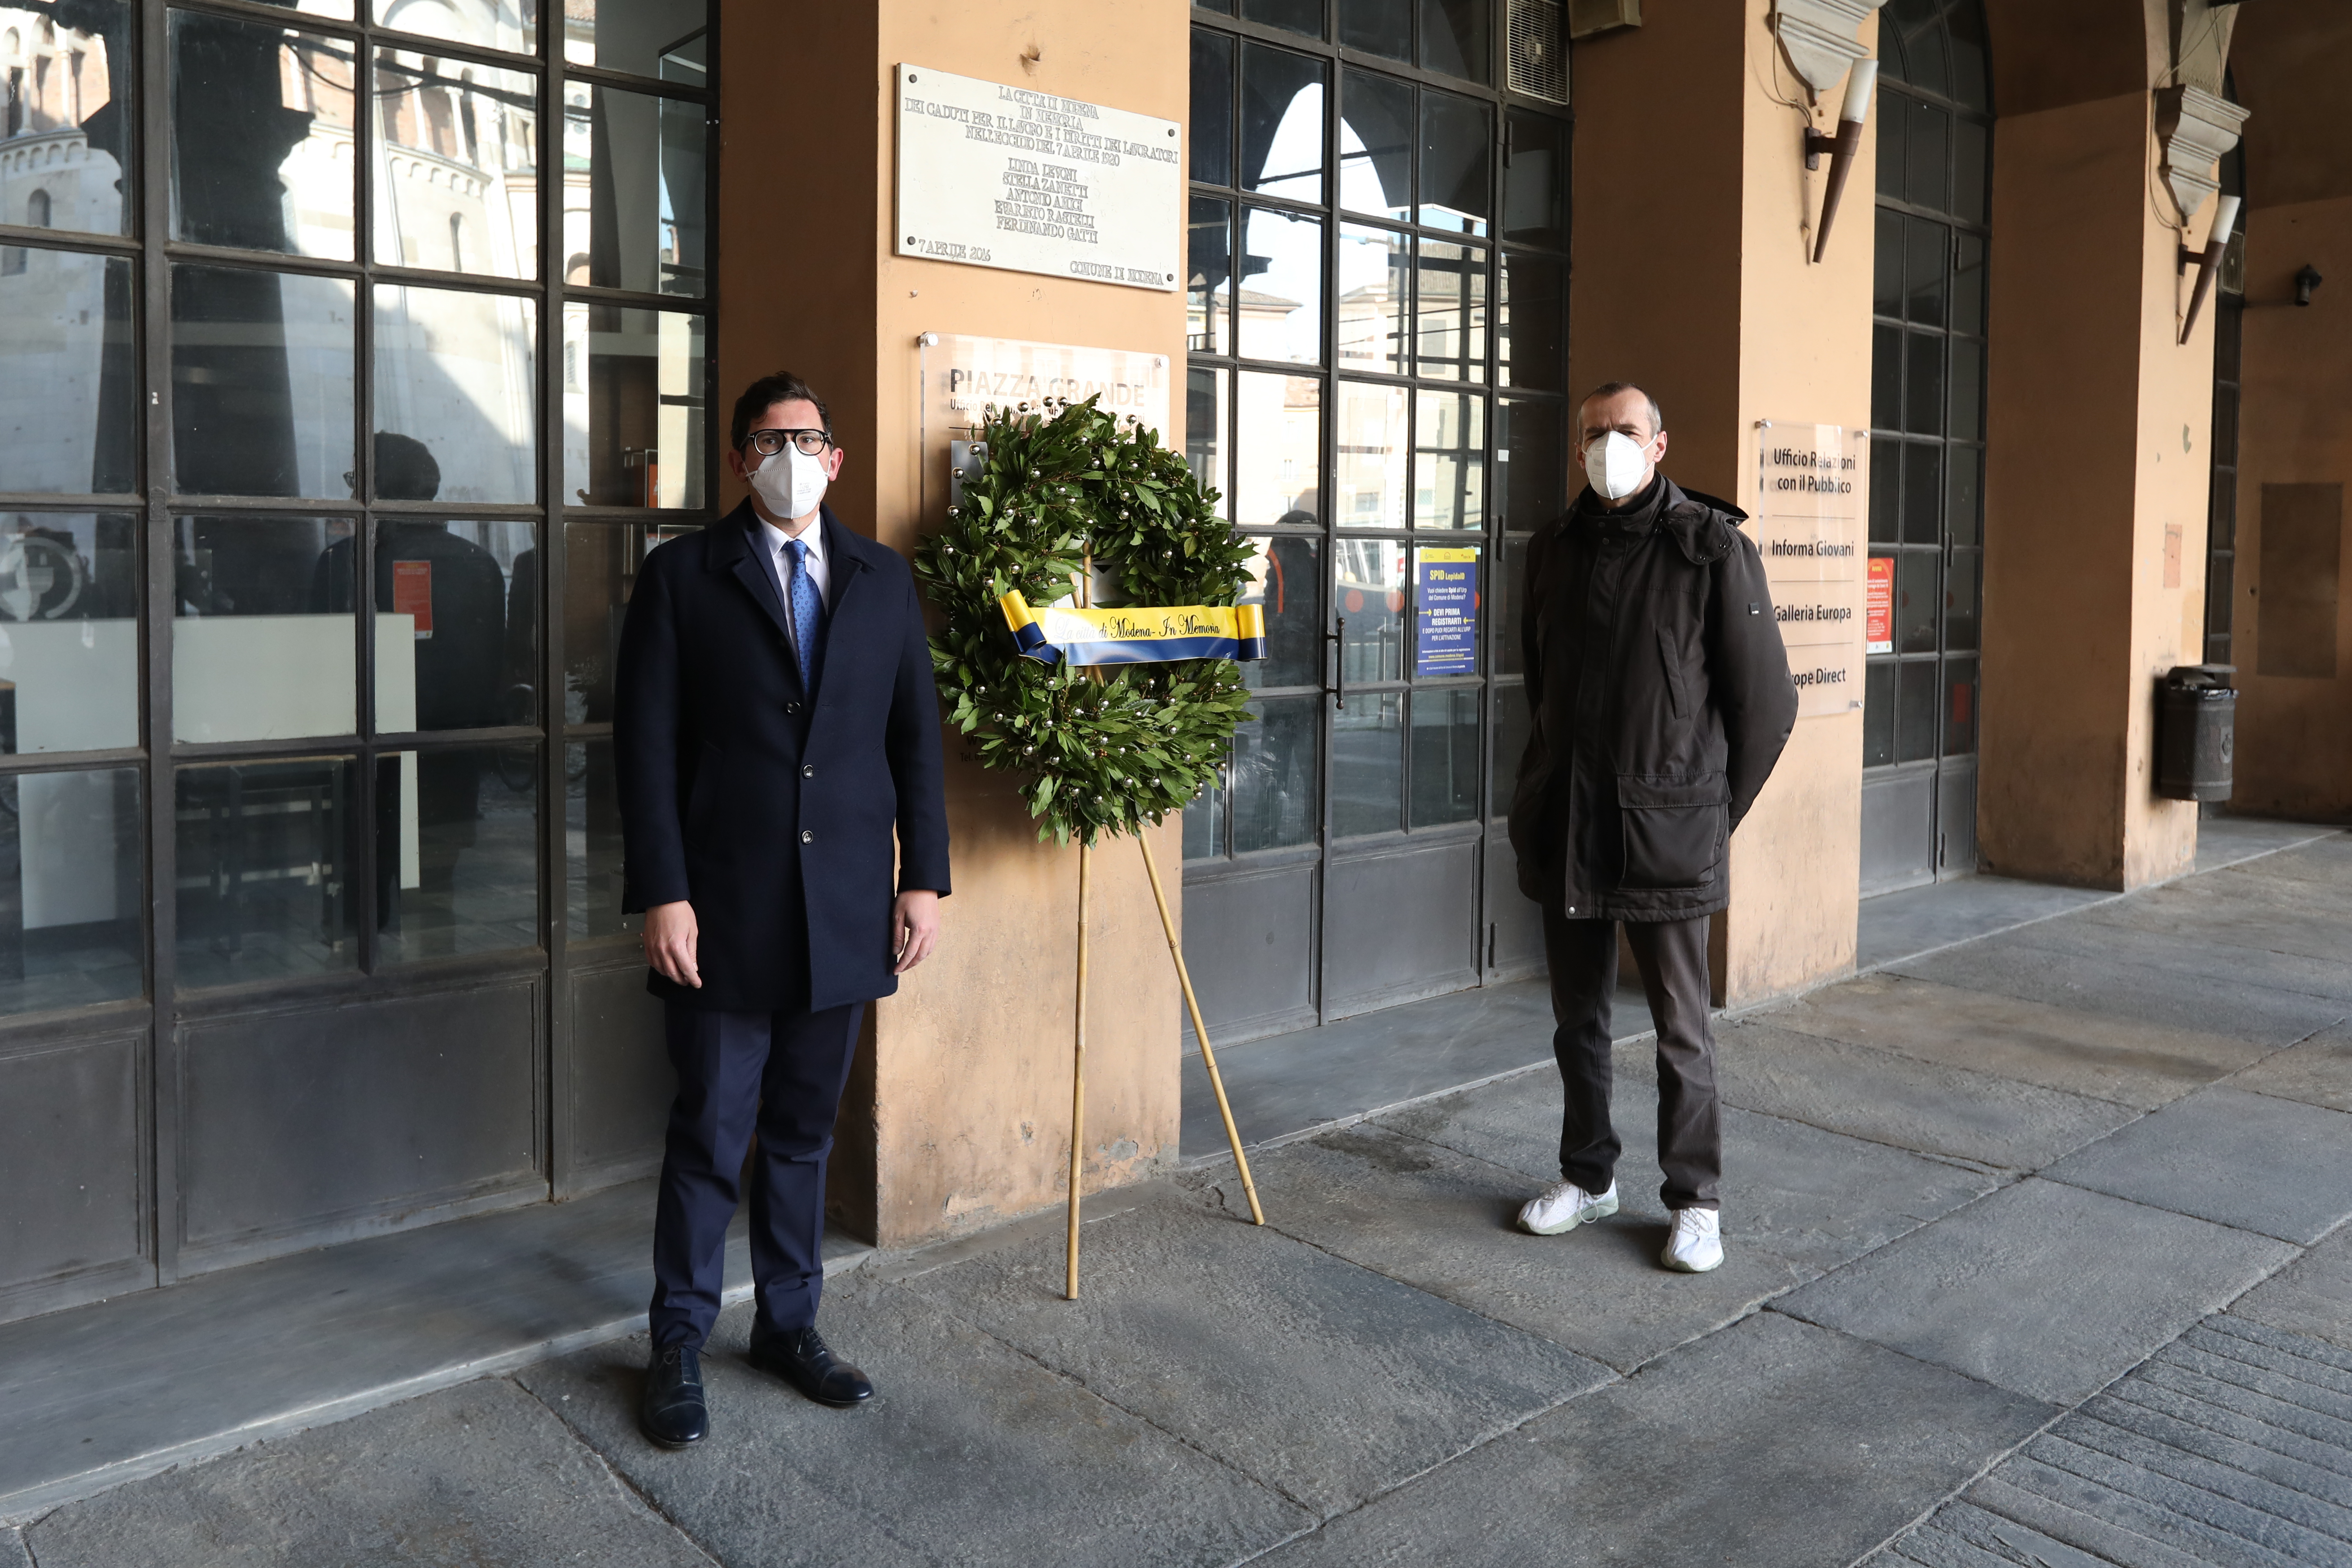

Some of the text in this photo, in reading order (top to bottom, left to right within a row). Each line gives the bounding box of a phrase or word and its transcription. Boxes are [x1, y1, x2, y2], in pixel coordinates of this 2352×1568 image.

[999, 86, 1012, 101] LA
[1047, 96, 1057, 110] DI
[1061, 100, 1099, 119] MODENA
[1020, 105, 1083, 131] IN MEMORIA
[905, 98, 1178, 164] DEI CADUTI PER IL LAVORO E I DIRITTI DEI LAVORATORI
[1036, 139, 1055, 154] DEL
[1056, 143, 1062, 155] 7
[1063, 145, 1099, 163] APRILE
[1101, 152, 1120, 166] 1920
[1008, 158, 1077, 182] LINDA LEVONI
[1003, 172, 1088, 198] STELLA ZANETTI
[1006, 188, 1082, 212] ANTONIO AMICI
[994, 199, 1094, 228] EVARISTO RASTELLI
[997, 216, 1098, 244] FERDINANDO GATTI
[919, 239, 991, 261] 7 APRILE 2016
[1070, 261, 1164, 285] COMUNE DI MODENA
[950, 369, 1144, 407] PIAZZA GRANDE
[950, 399, 977, 411] Ufficio
[1774, 448, 1855, 470] Ufficio Relazioni
[1778, 474, 1851, 493] con il Pubblico
[1773, 539, 1854, 556] Informa Giovani
[1430, 569, 1465, 582] SPID LepidaID
[1432, 617, 1462, 626] REGISTRARTI
[1445, 608, 1460, 616] PRIMA
[1774, 604, 1851, 623] Galleria Europa
[1054, 617, 1074, 640] La
[1076, 624, 1096, 639] città
[1099, 622, 1108, 638] di
[1159, 616, 1176, 636] In
[1178, 614, 1220, 635] Memoria
[1816, 667, 1846, 684] Direct
